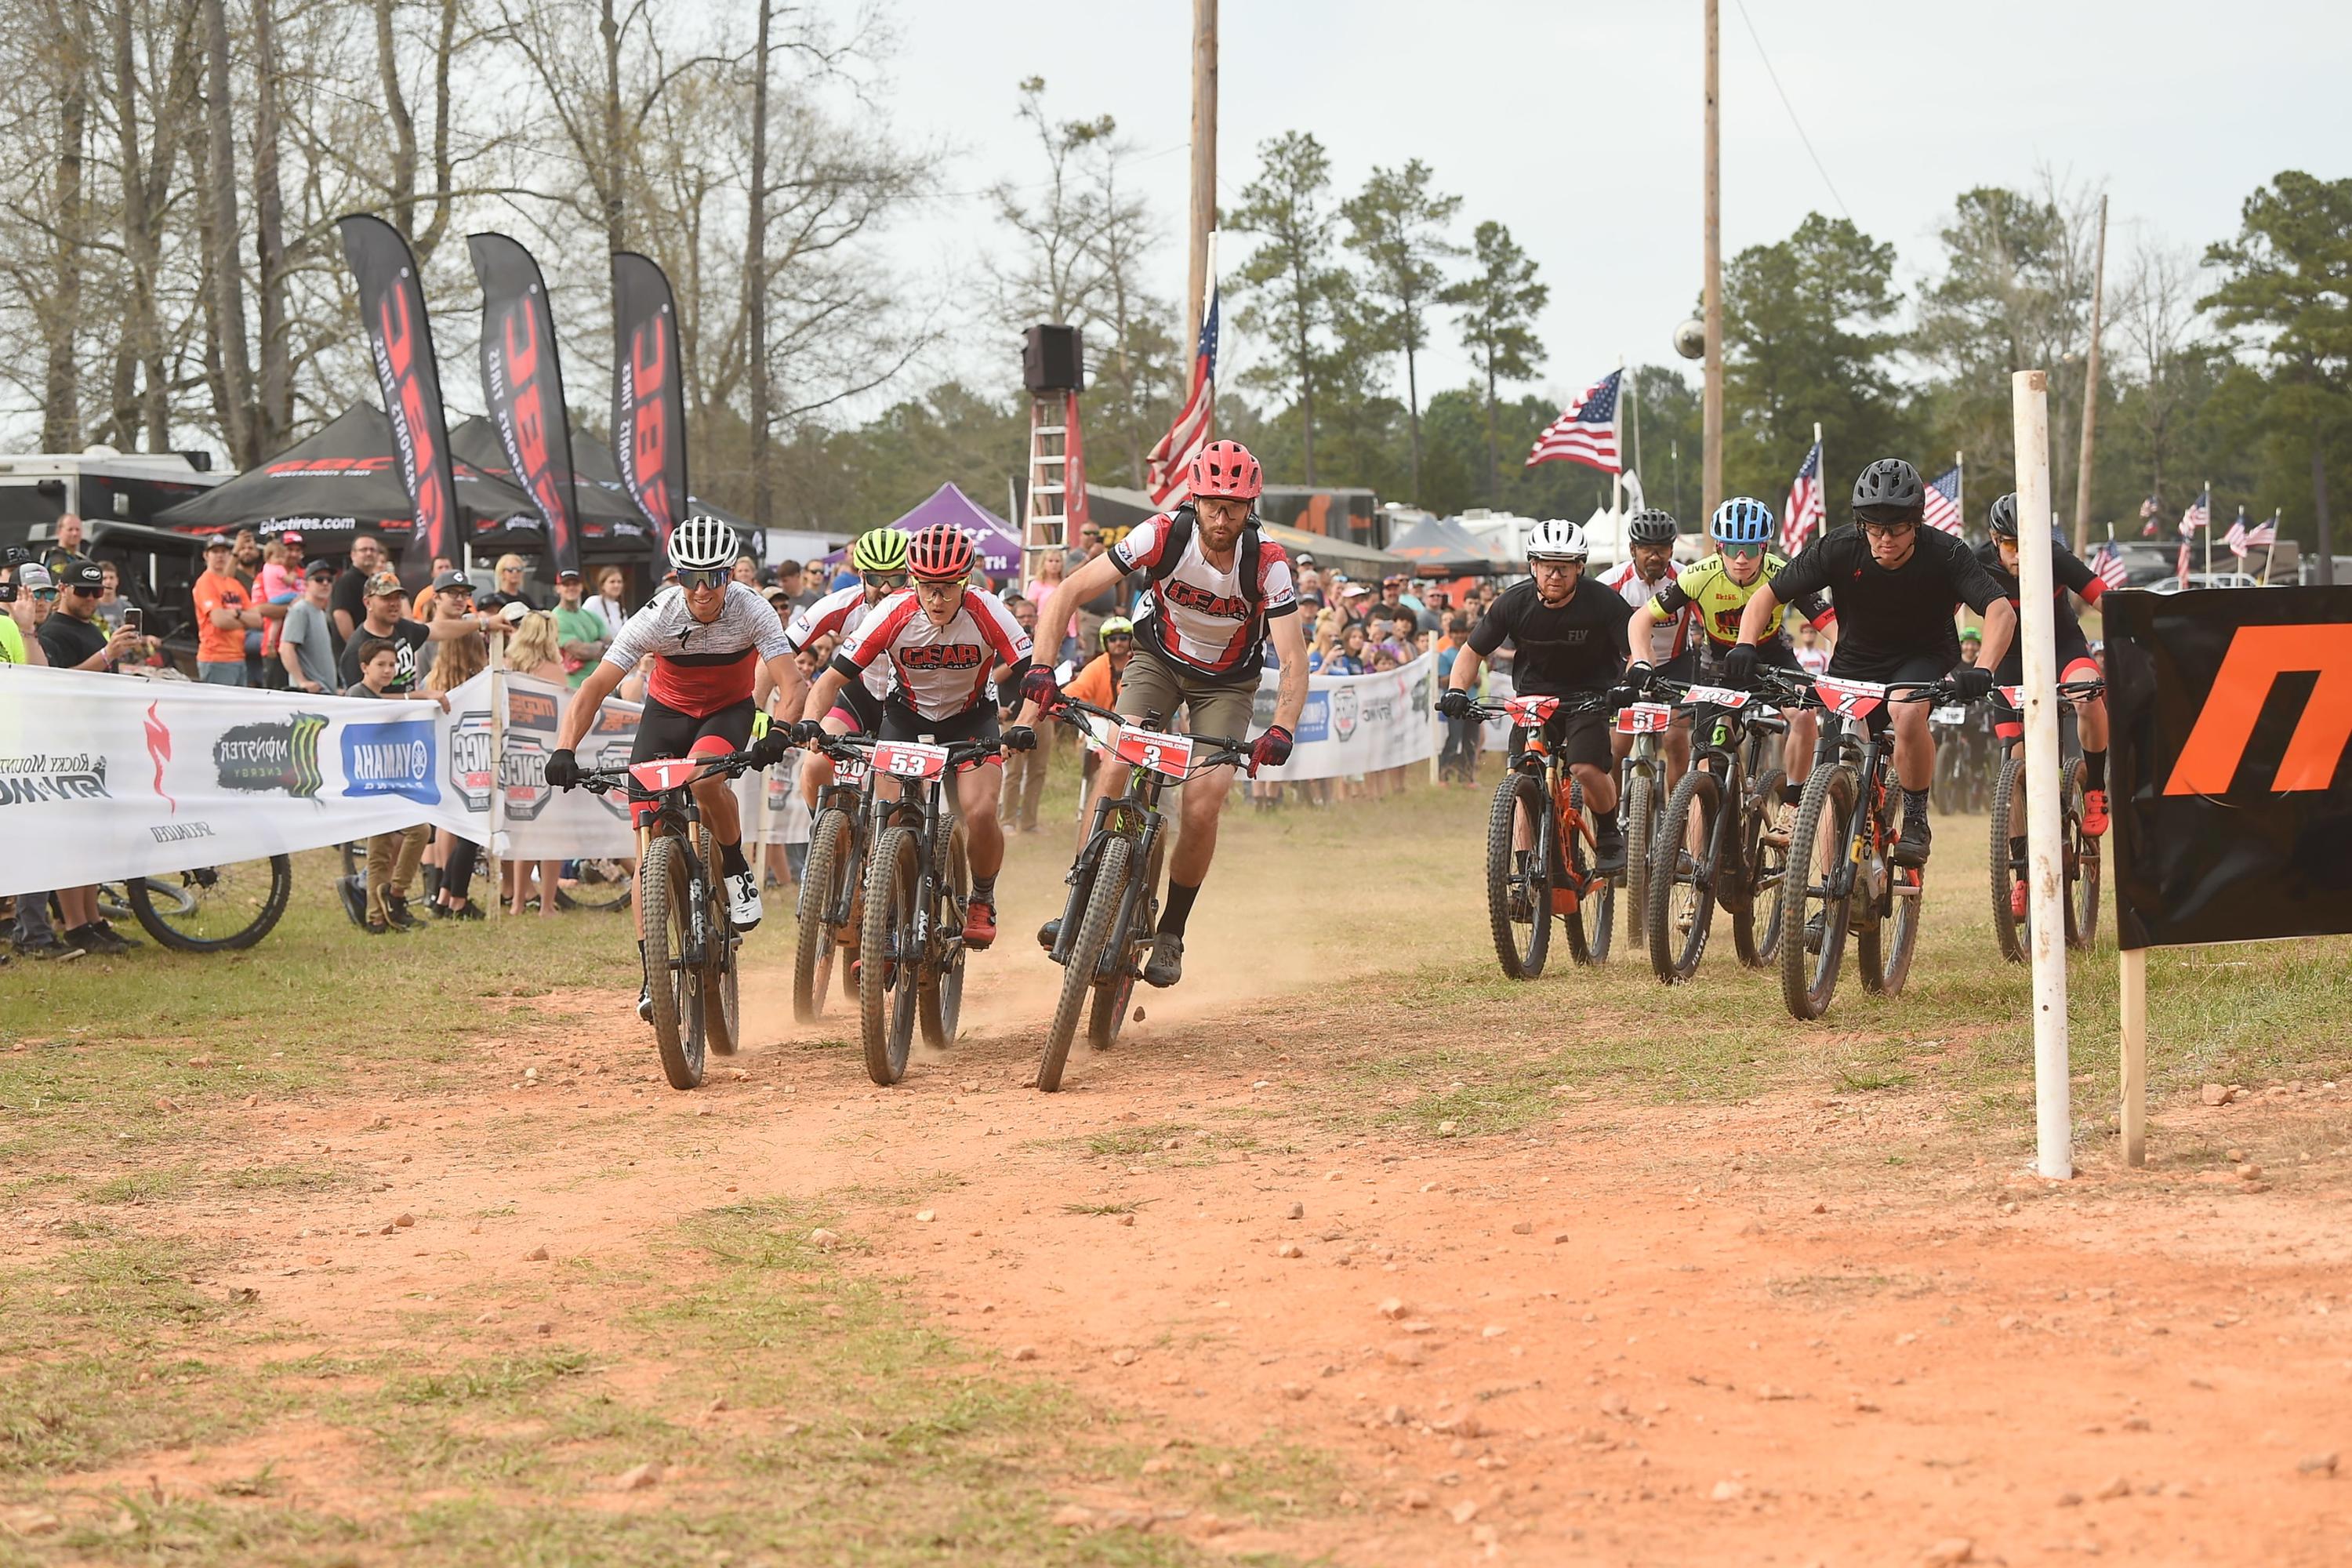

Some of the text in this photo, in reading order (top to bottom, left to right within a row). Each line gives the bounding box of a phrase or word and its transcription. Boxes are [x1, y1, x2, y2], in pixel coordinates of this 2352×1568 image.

[259, 517, 356, 535] gbctires.com
[1687, 561, 1718, 574] LIVE IT
[903, 644, 978, 665] GEAR
[1632, 710, 1655, 729] 51
[1133, 735, 1190, 751] GNCCRACING.COM
[888, 753, 927, 775] 53
[1142, 744, 1162, 768] 3
[655, 765, 670, 789] 1
[918, 909, 930, 941] FOX
